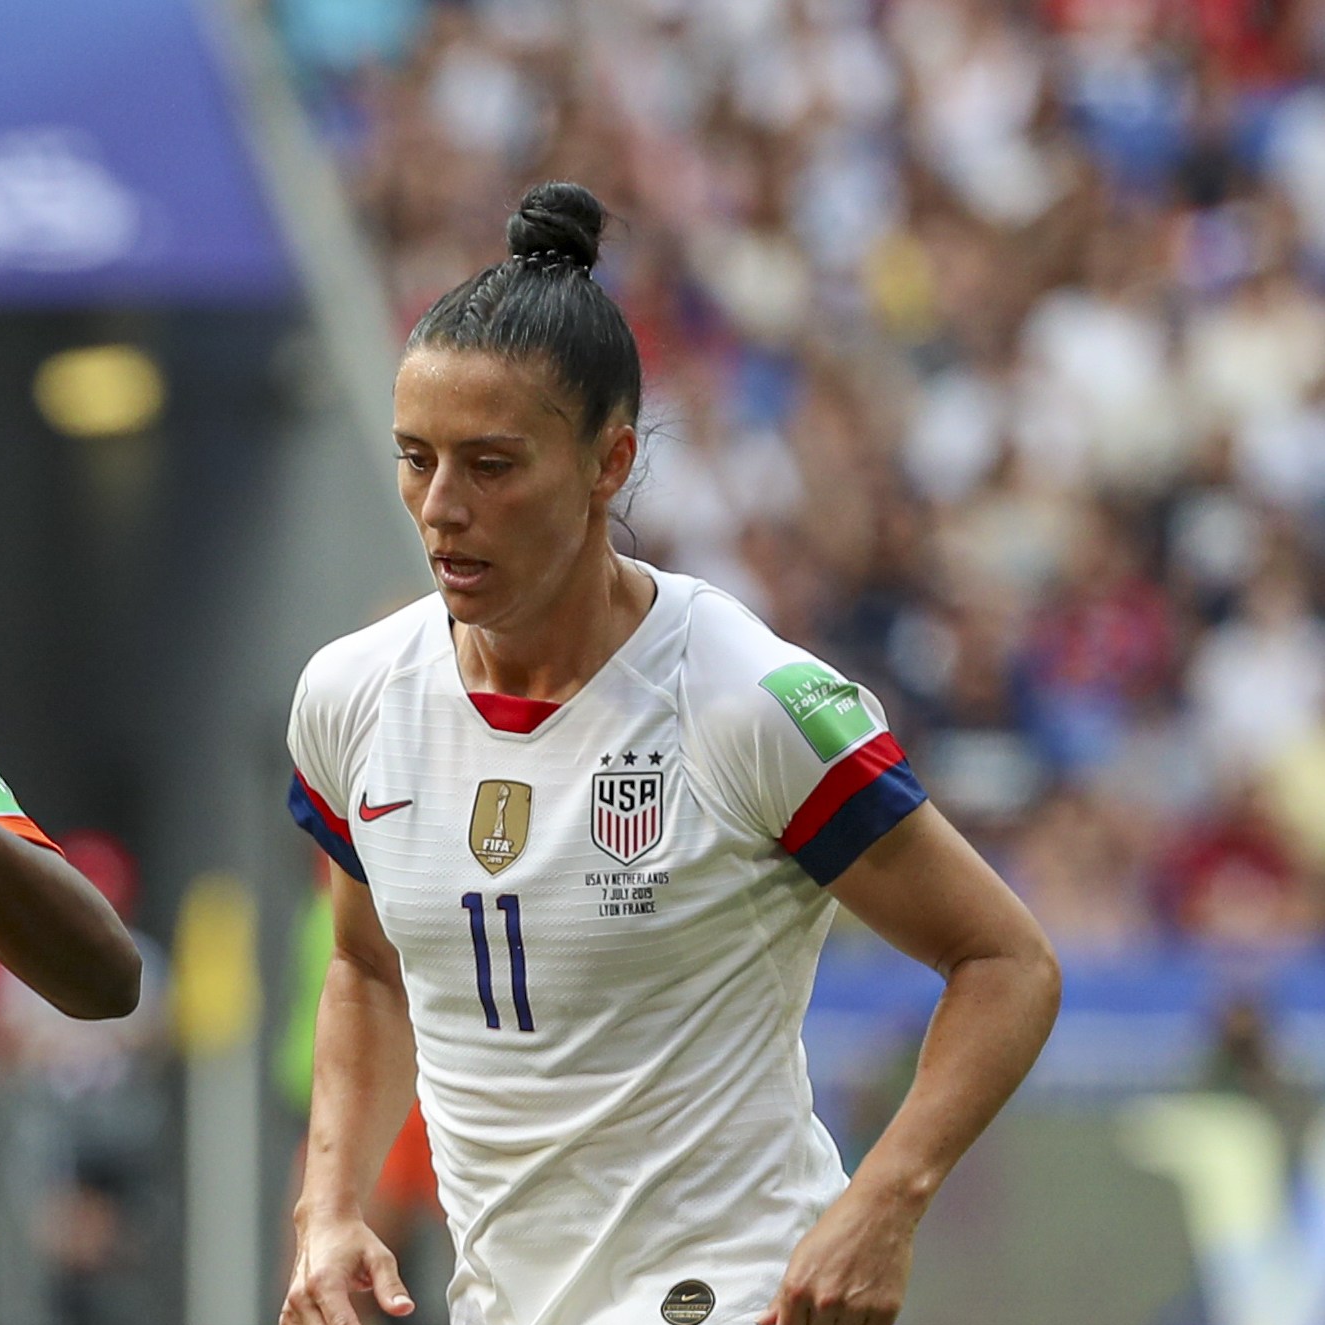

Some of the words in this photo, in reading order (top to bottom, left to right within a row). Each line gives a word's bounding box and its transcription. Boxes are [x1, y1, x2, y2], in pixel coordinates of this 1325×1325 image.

[599, 779, 656, 812] USA
[482, 838, 511, 853] FIFA
[585, 873, 602, 886] USA
[604, 873, 610, 885] V
[612, 872, 669, 885] NETHERLANDS
[602, 888, 608, 901] 7
[611, 888, 629, 901] JULY
[632, 887, 653, 900] 2019
[599, 903, 620, 917] LYON
[623, 901, 656, 916] FRANCE
[461, 891, 535, 1032] 11
